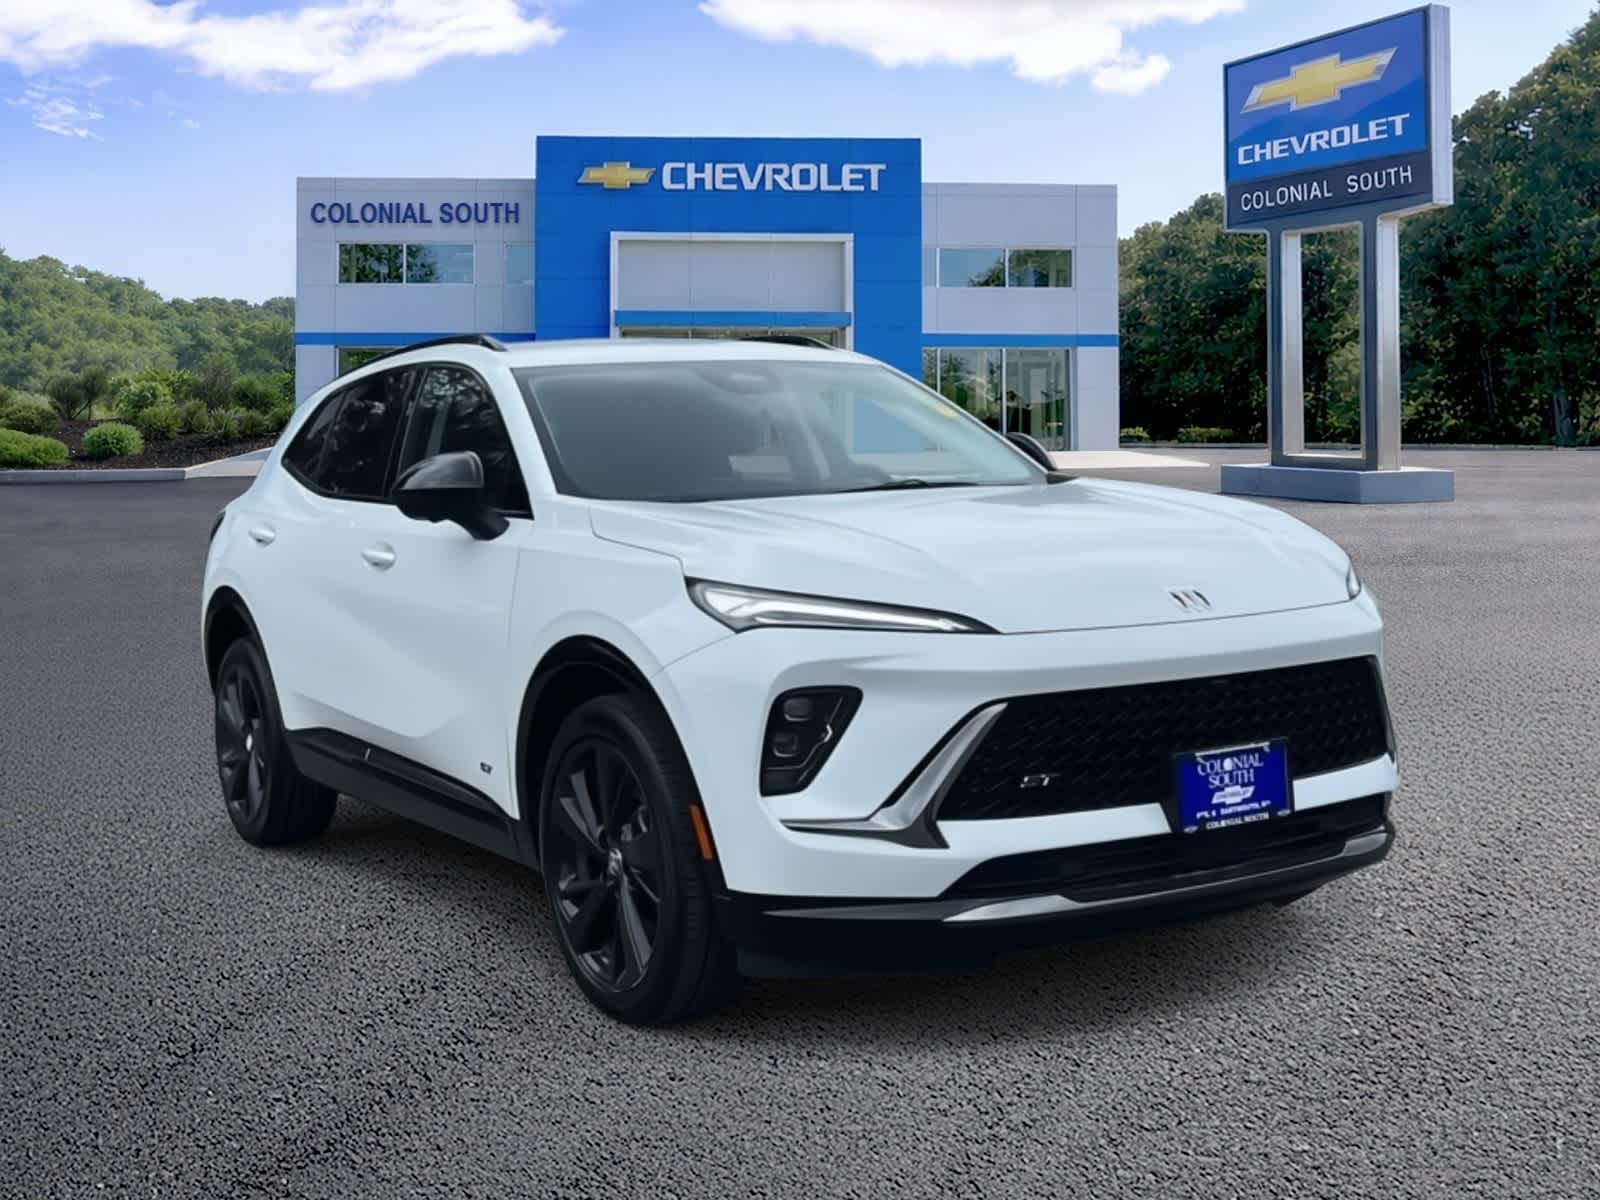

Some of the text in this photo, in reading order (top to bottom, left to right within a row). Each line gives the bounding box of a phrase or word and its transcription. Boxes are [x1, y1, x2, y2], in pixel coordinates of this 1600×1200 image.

[1237, 112, 1410, 165] CHEVROLET
[662, 162, 886, 191] CHEVROLET
[1240, 165, 1412, 211] COLONIAL SOUTH
[310, 202, 520, 224] COLONIAL SOUTH
[1197, 754, 1264, 776] COLONIAL
[1208, 768, 1255, 788] SOUTH
